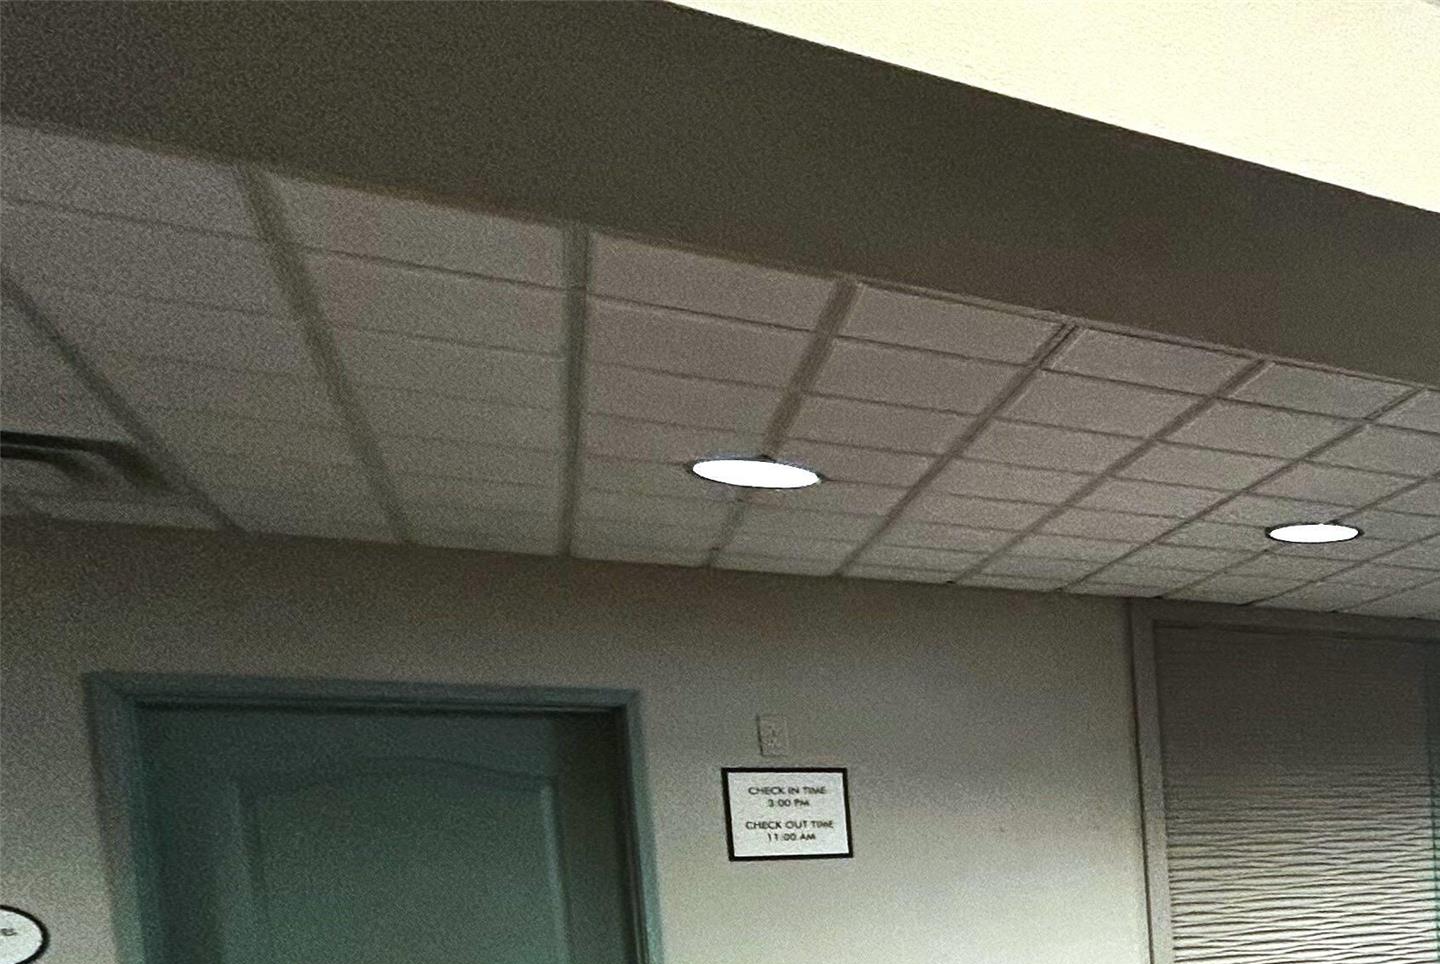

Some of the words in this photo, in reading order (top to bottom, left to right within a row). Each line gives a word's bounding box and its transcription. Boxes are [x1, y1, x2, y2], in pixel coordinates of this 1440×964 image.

[748, 786, 785, 795] CHECK
[788, 786, 800, 795] IN
[803, 786, 827, 795] TIME
[794, 799, 810, 807] PM
[745, 821, 782, 830] CHECK
[785, 821, 807, 829] OUT
[811, 820, 834, 829] TIME
[800, 833, 816, 841] AM
